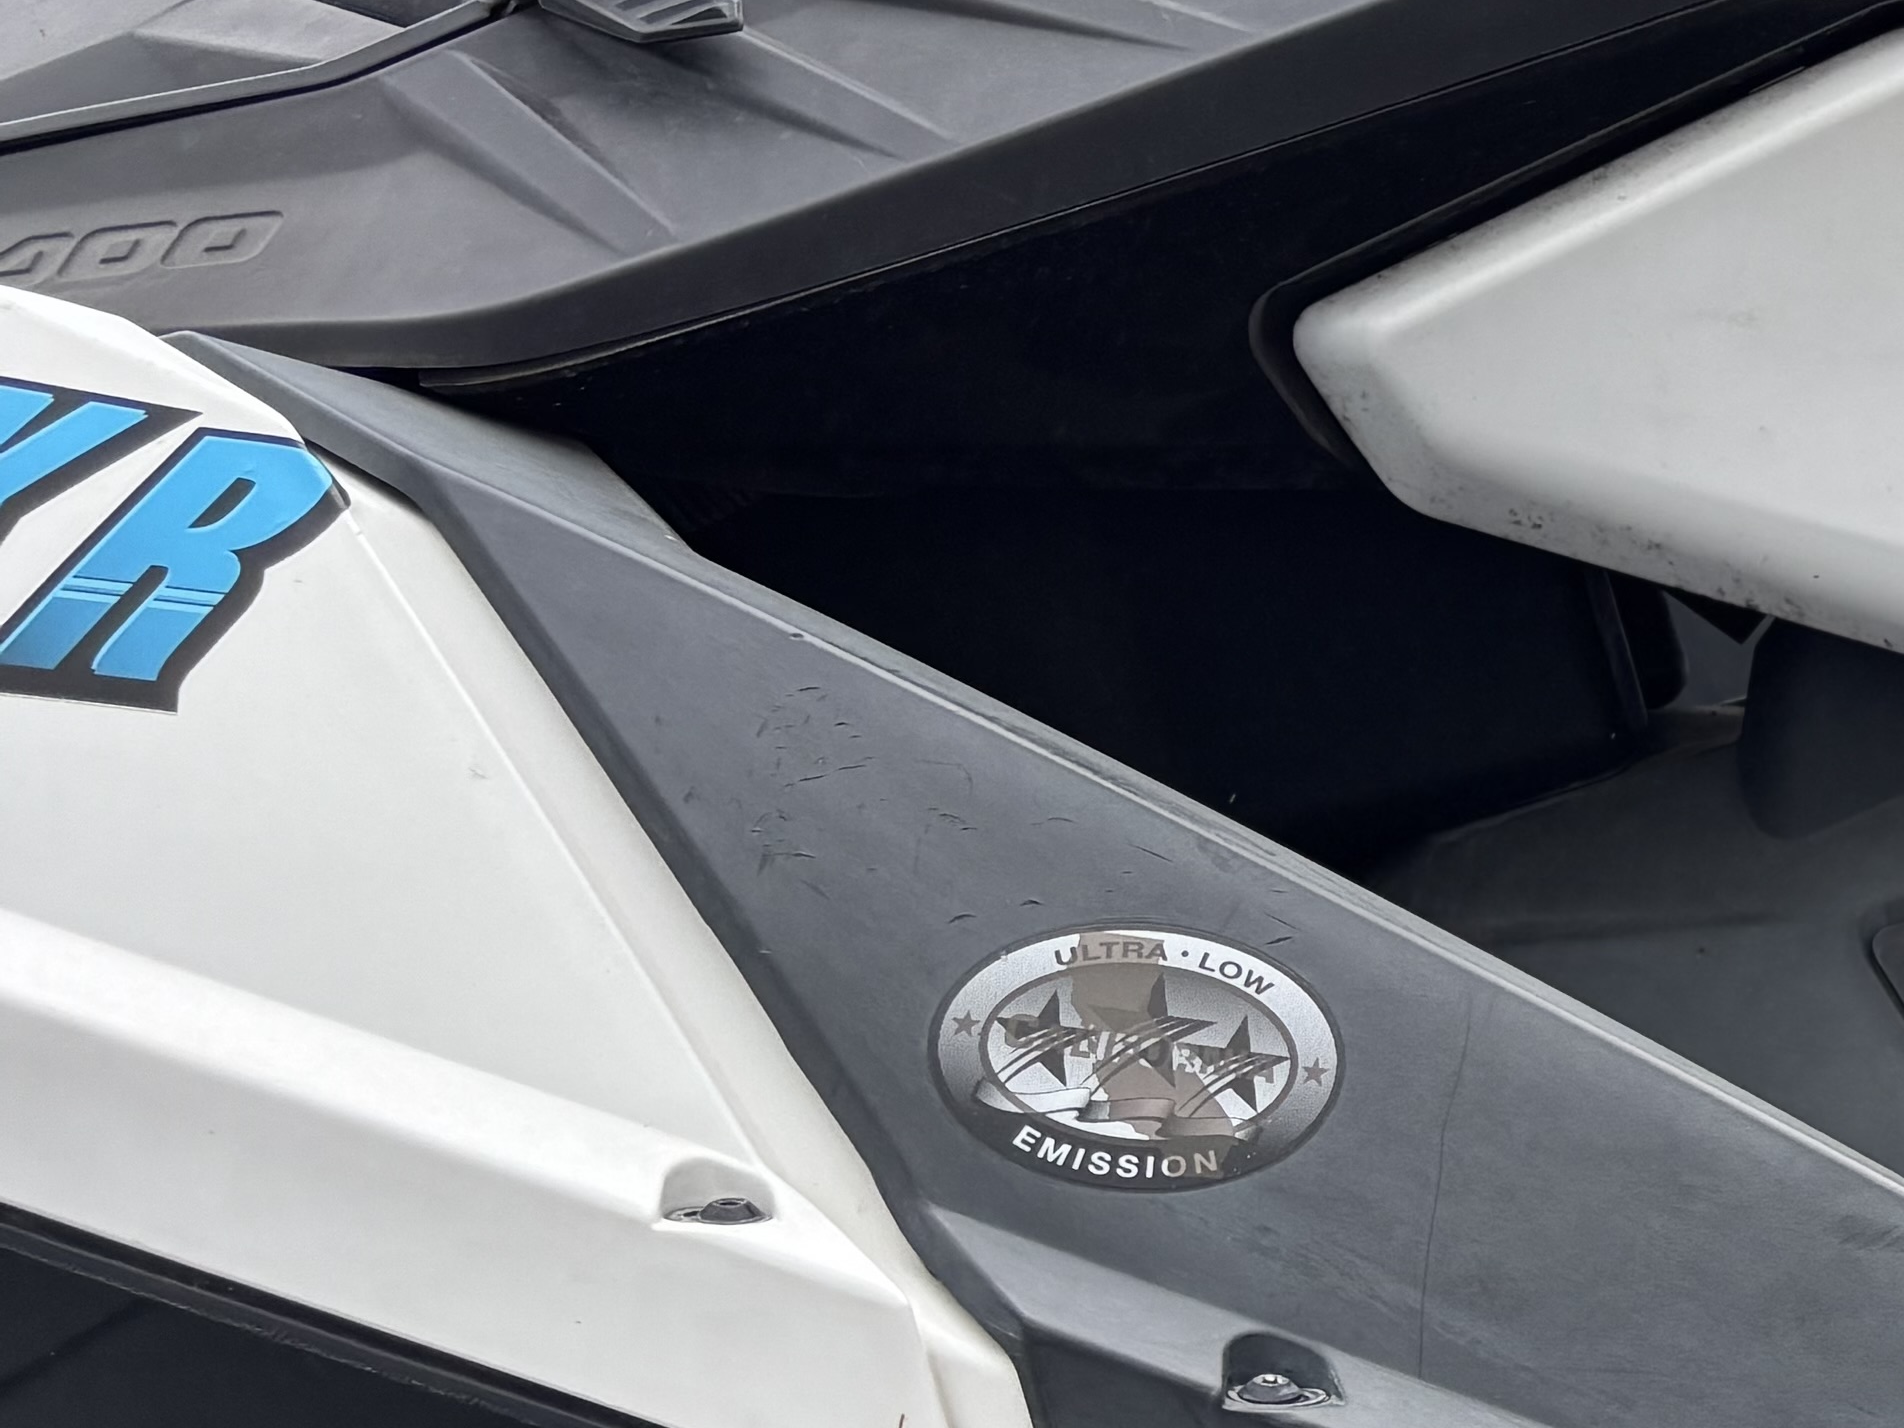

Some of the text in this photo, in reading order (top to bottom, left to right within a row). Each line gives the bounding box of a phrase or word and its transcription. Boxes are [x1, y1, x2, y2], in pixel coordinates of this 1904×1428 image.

[1053, 940, 1276, 996] ULTRA LOW
[1011, 1123, 1219, 1179] EMISSION
